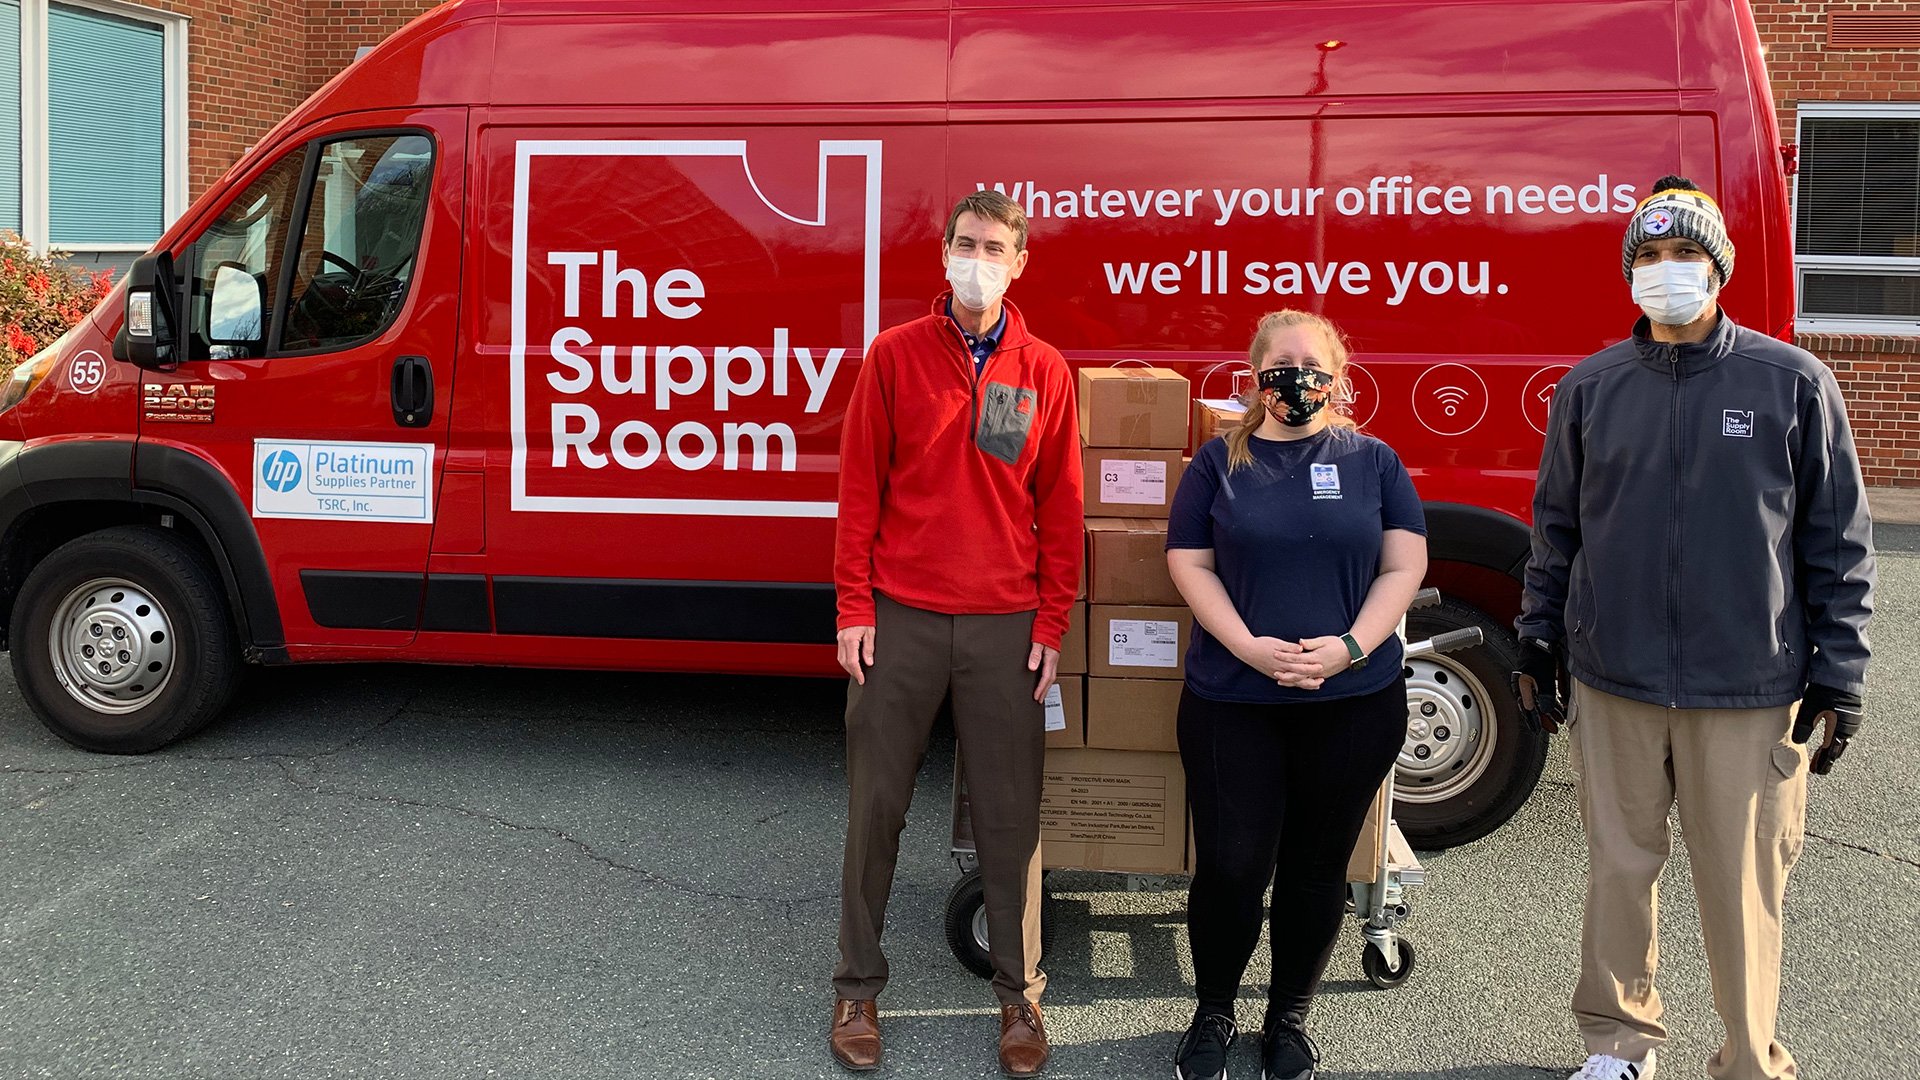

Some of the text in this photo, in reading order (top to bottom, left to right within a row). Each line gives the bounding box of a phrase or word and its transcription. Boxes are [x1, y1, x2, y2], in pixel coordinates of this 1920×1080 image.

[1214, 188, 1323, 227] your
[1335, 175, 1473, 216] office
[1486, 174, 1638, 215] needs
[547, 250, 706, 319] The
[1243, 261, 1371, 295] save
[1384, 260, 1509, 306] you.
[73, 361, 101, 384] 55
[546, 326, 846, 413] Supply
[144, 384, 216, 397] RAM
[144, 396, 215, 410] 2500
[551, 402, 797, 472] Room
[1726, 422, 1750, 430] Supply
[263, 450, 301, 492] hp
[316, 452, 414, 475] Platinum
[315, 475, 416, 489] Supplies Partner
[1104, 473, 1119, 482] C3
[317, 499, 373, 512] TSRC, Inc.
[1113, 633, 1128, 643] C3
